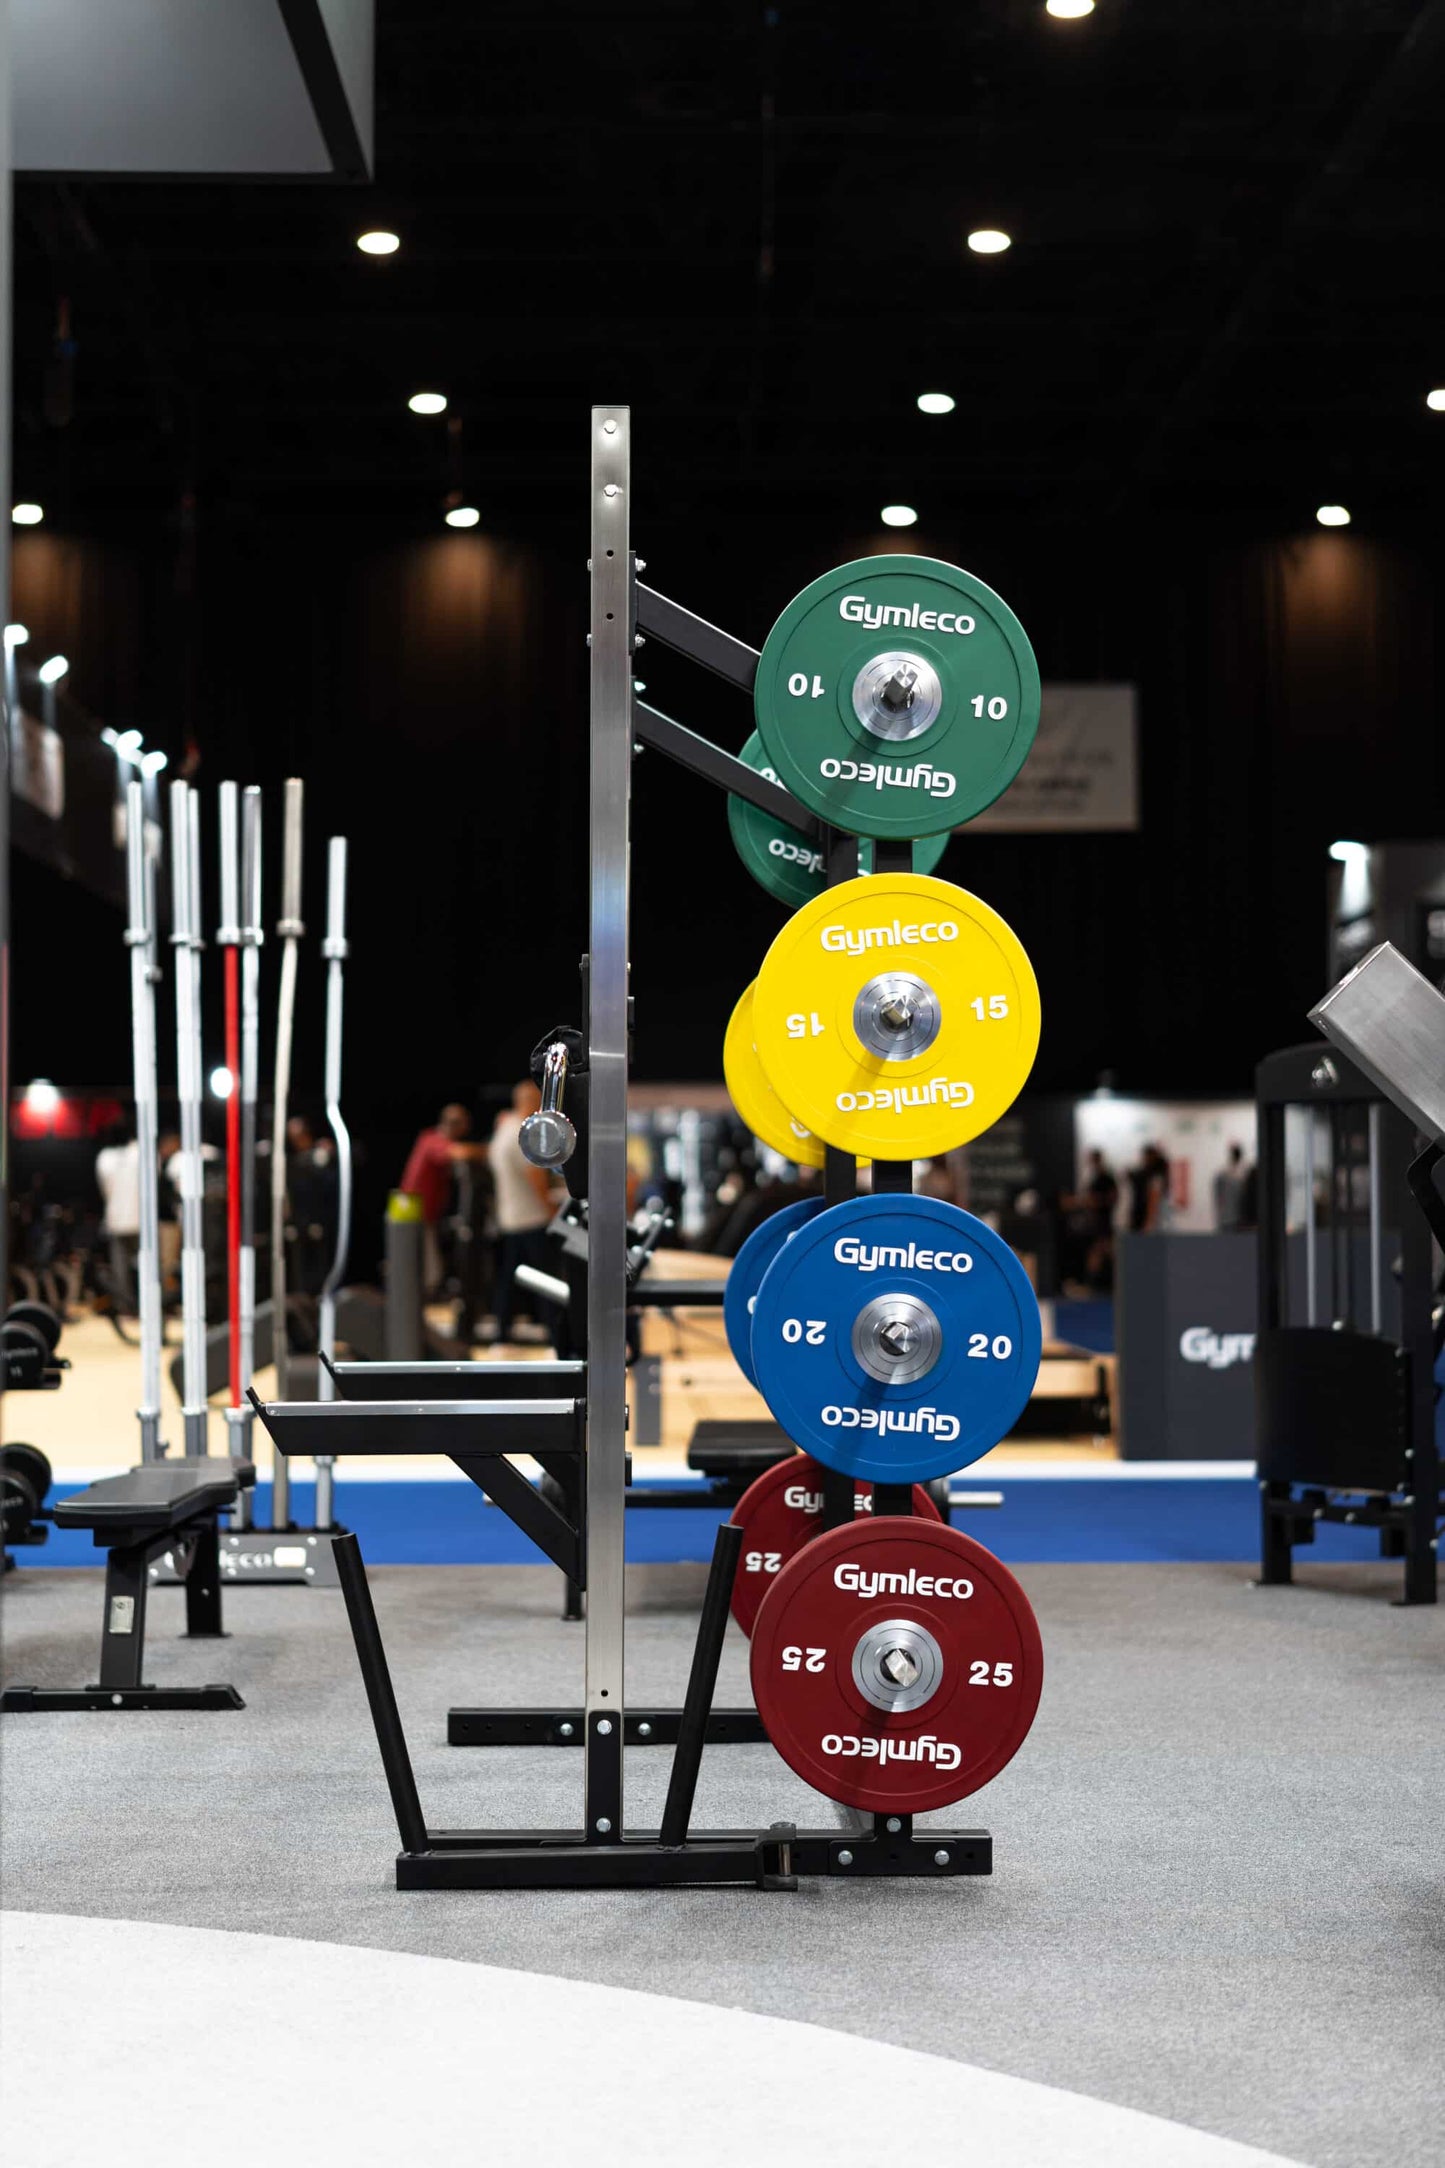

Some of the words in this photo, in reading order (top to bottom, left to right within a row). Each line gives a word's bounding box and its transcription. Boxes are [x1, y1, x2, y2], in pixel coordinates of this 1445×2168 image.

[840, 596, 976, 634] Gymleco
[788, 673, 825, 698] 10
[970, 695, 1008, 720] 10
[820, 759, 956, 797] Gymleco
[820, 919, 958, 956] Gymleco
[970, 995, 1008, 1020] 15
[786, 1013, 825, 1038] 15
[836, 1077, 975, 1114] Gymleco
[834, 1237, 973, 1273] Gymleco
[782, 1319, 827, 1344] 20
[967, 1334, 1012, 1359] 20
[821, 1406, 960, 1441] Gymleco
[745, 1551, 781, 1572] 25
[834, 1563, 974, 1599] Gymleco
[782, 1647, 827, 1673] 25
[968, 1661, 1013, 1687] 25
[821, 1735, 962, 1770] Gymleco
